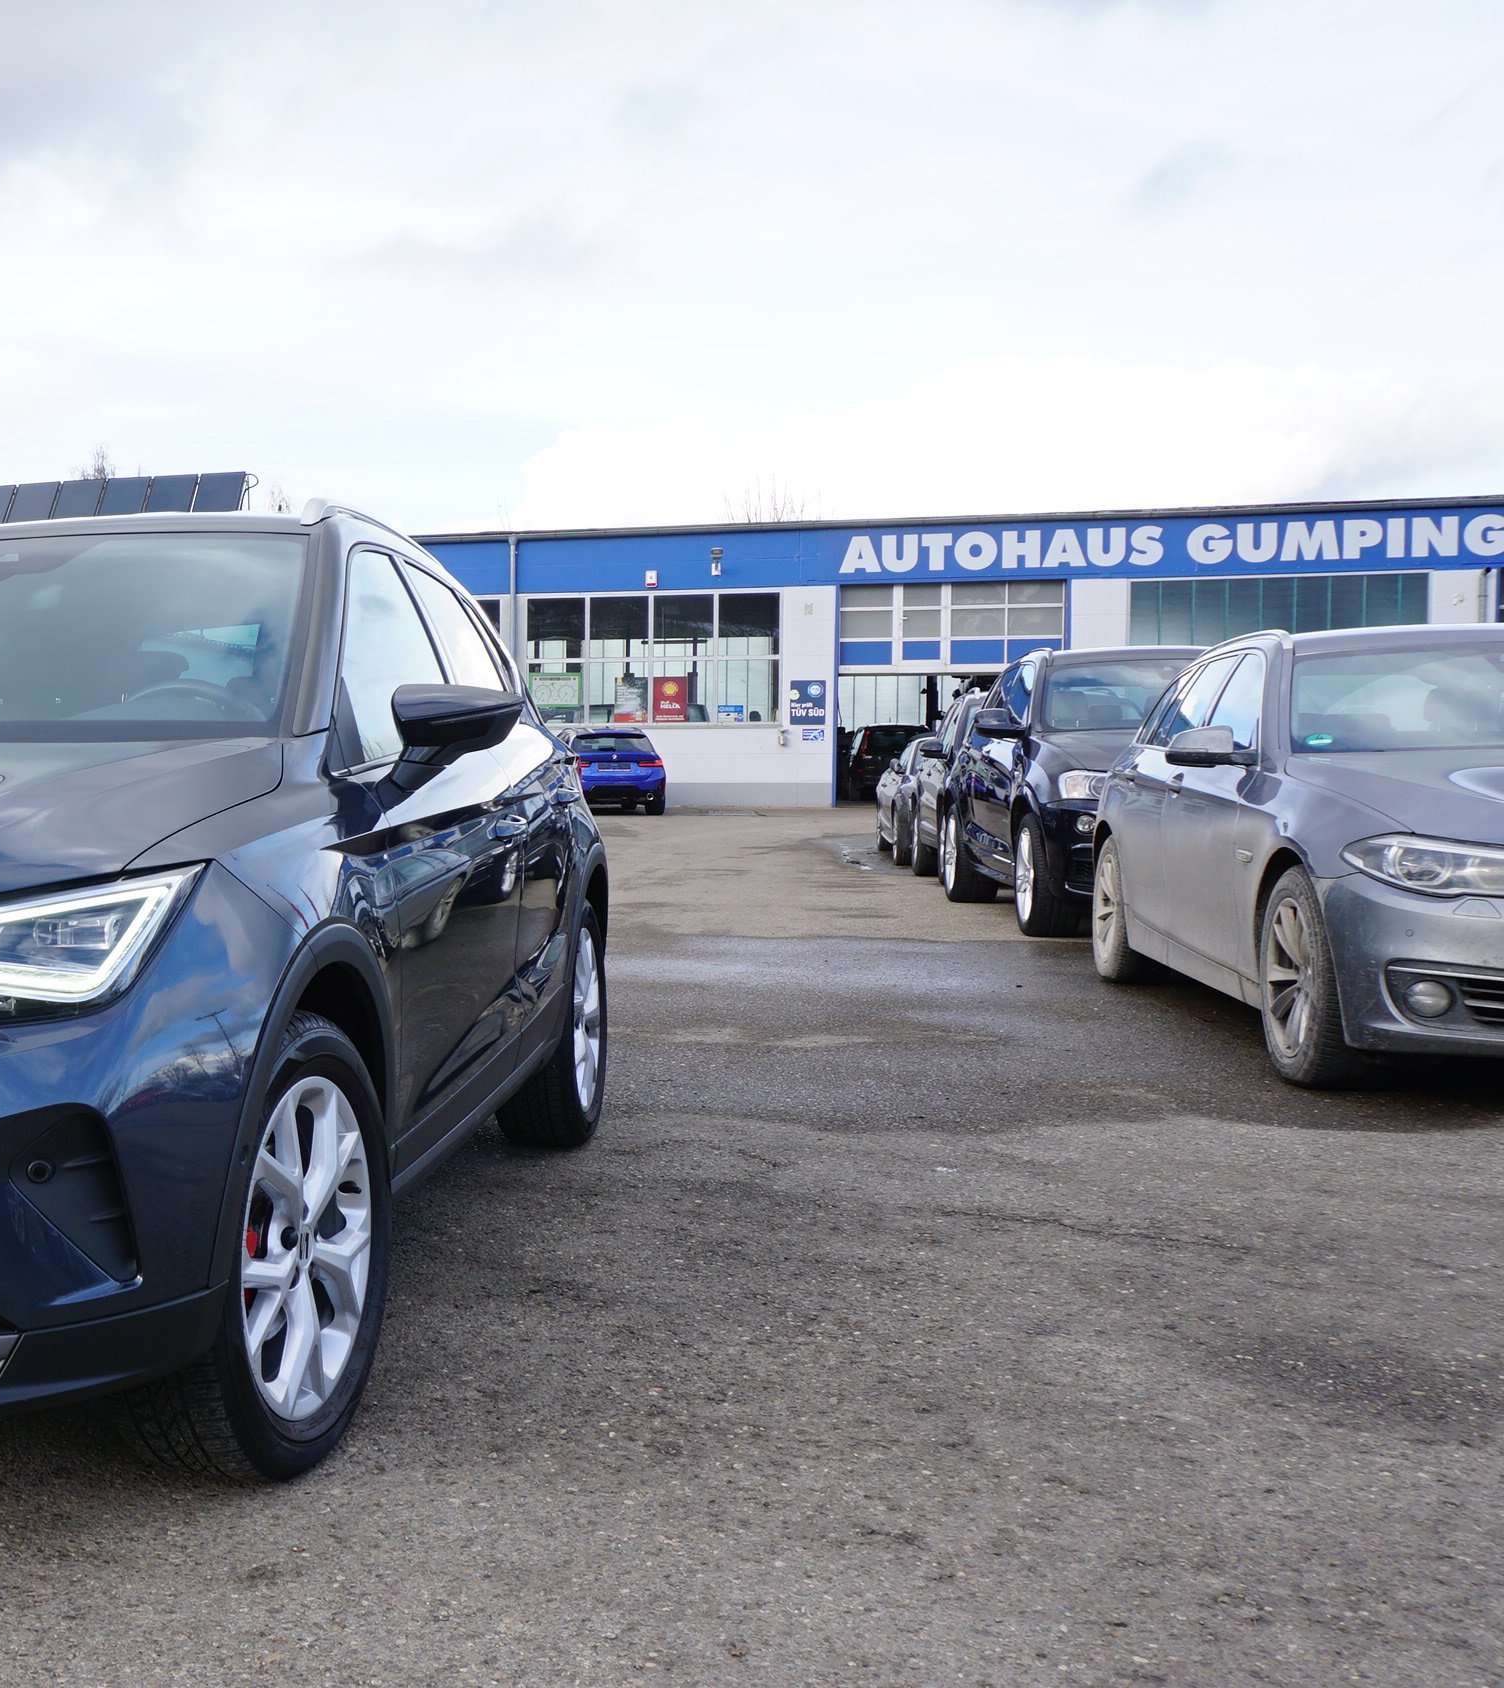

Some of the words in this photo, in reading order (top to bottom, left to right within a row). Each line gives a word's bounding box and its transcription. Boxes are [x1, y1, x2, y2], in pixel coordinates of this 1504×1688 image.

[838, 526, 1164, 574] AUTOHAUS
[1186, 513, 1504, 566] GUMPING
[791, 707, 807, 717] TÜV
[808, 707, 825, 717] SÜD
